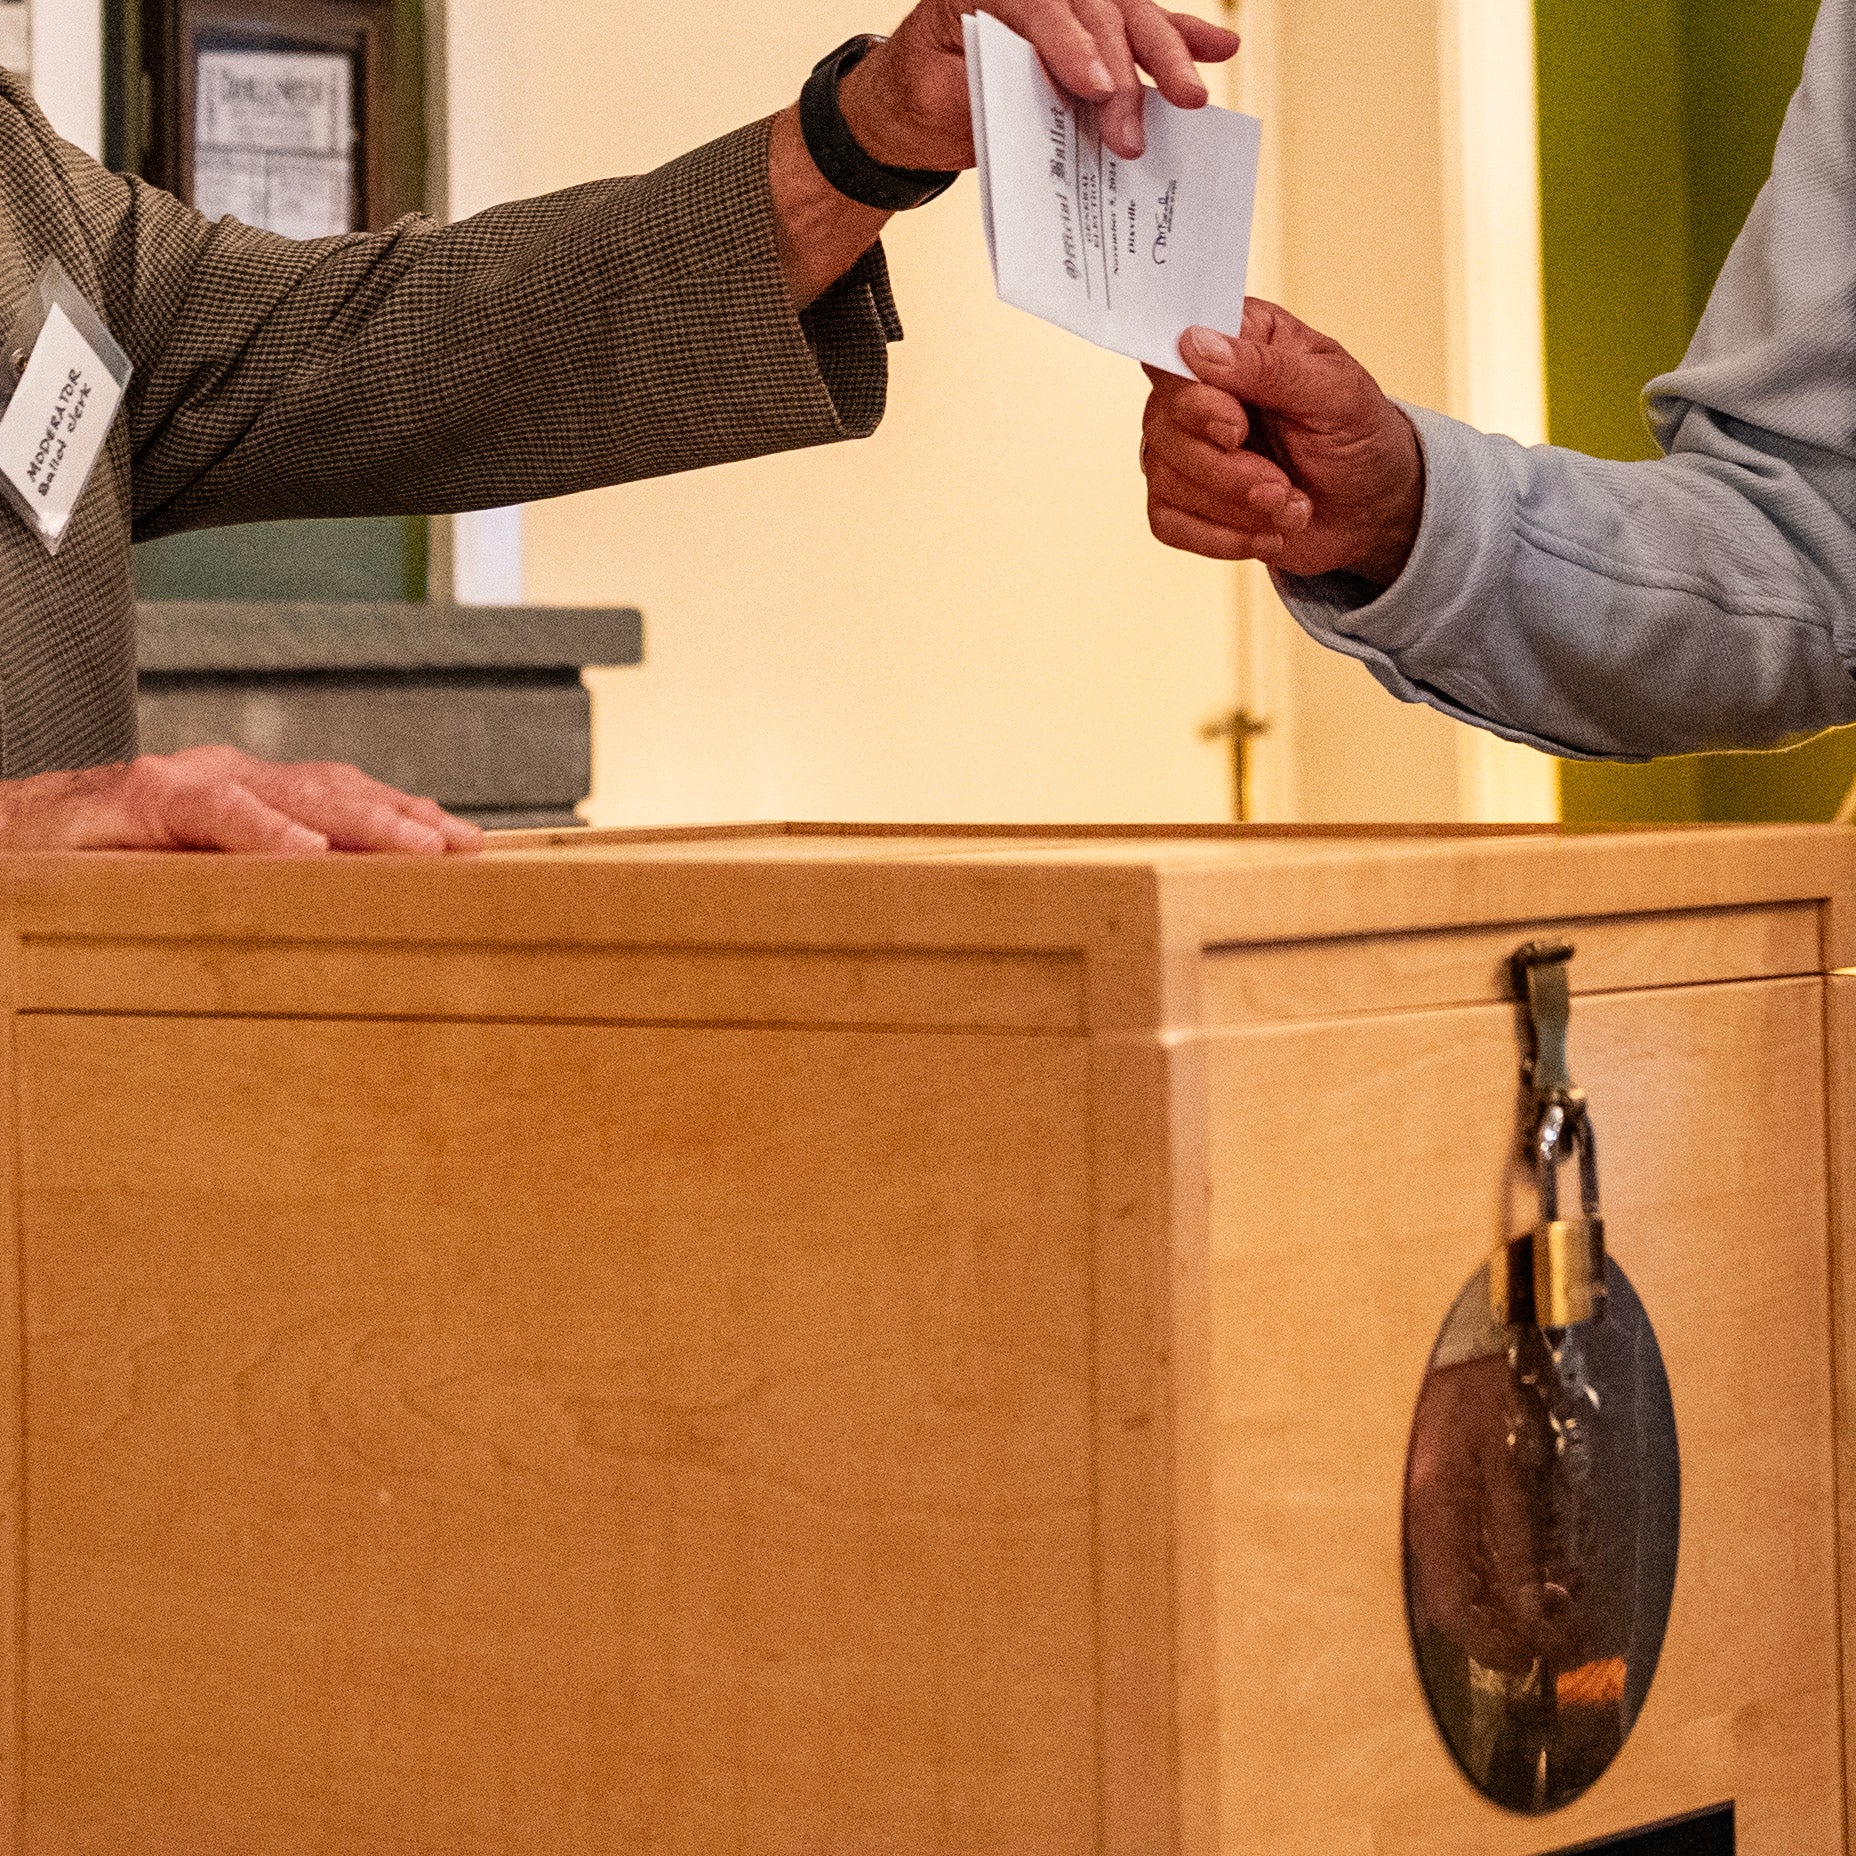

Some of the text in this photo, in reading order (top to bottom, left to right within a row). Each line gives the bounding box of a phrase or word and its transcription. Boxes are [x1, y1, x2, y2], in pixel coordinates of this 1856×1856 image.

[1050, 106, 1070, 185] Ballot
[1127, 199, 1136, 254] Dixville
[26, 367, 82, 483] MODERATOR
[37, 440, 67, 497] Ballot
